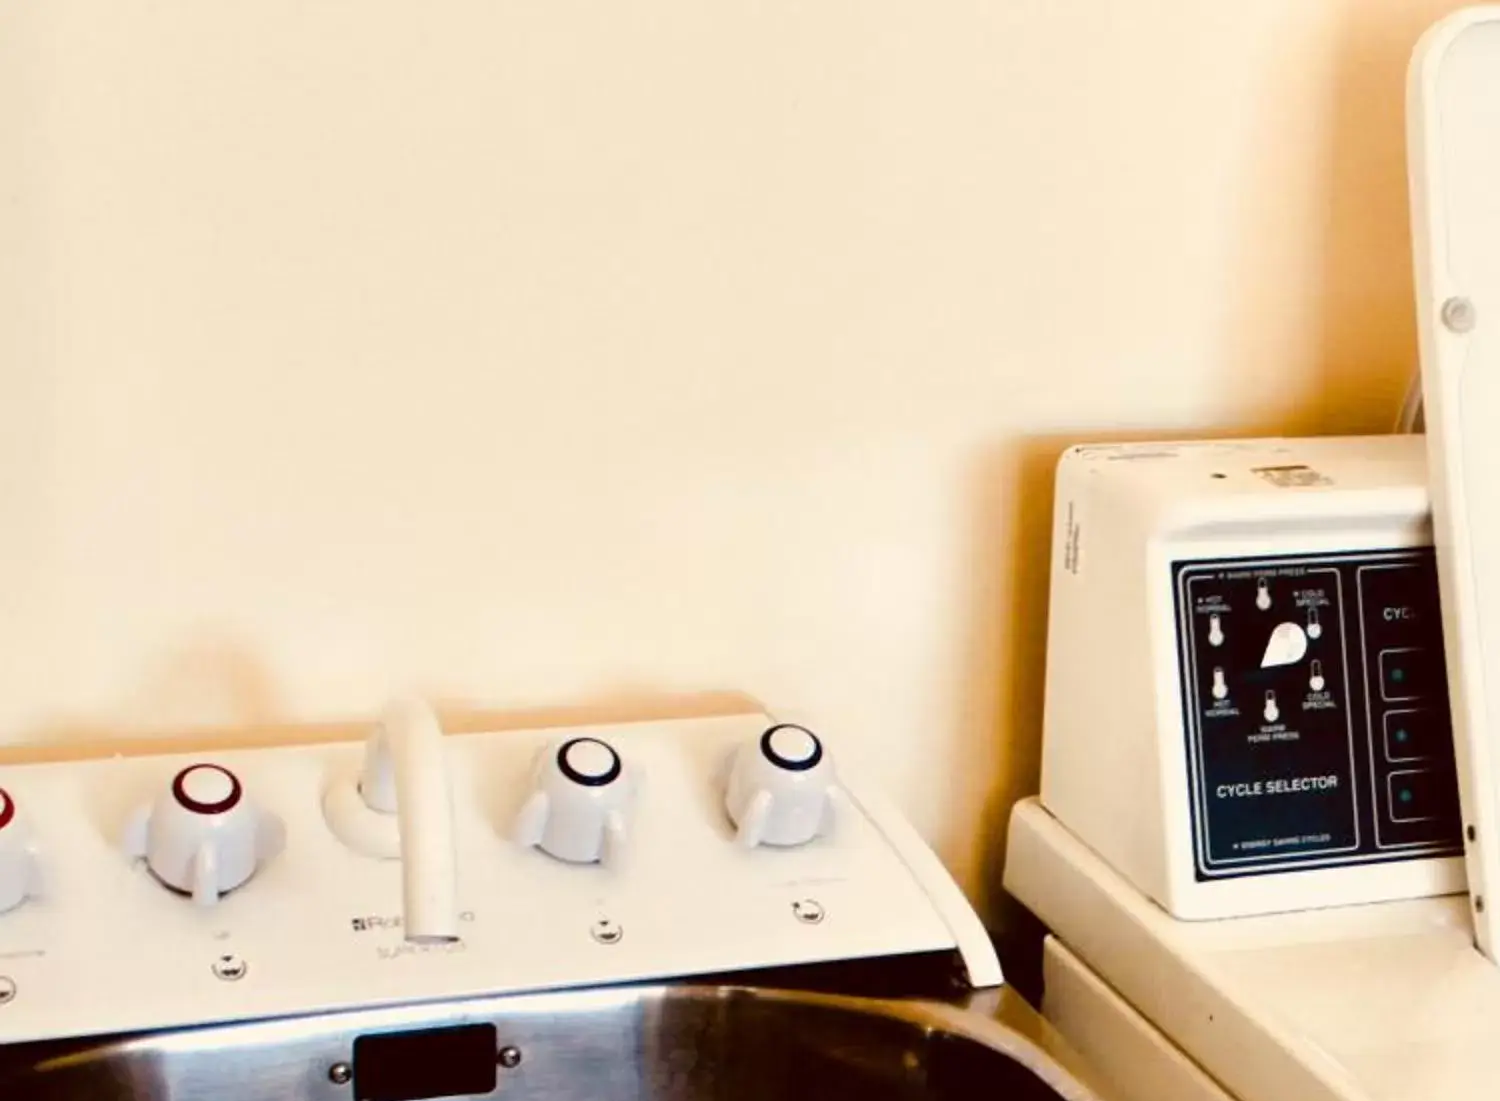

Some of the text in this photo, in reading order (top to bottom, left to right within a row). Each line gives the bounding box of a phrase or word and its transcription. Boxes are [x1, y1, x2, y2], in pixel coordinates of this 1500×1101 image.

[1383, 607, 1411, 620] CYC
[1216, 775, 1338, 798] CYCLE SELECTOR
